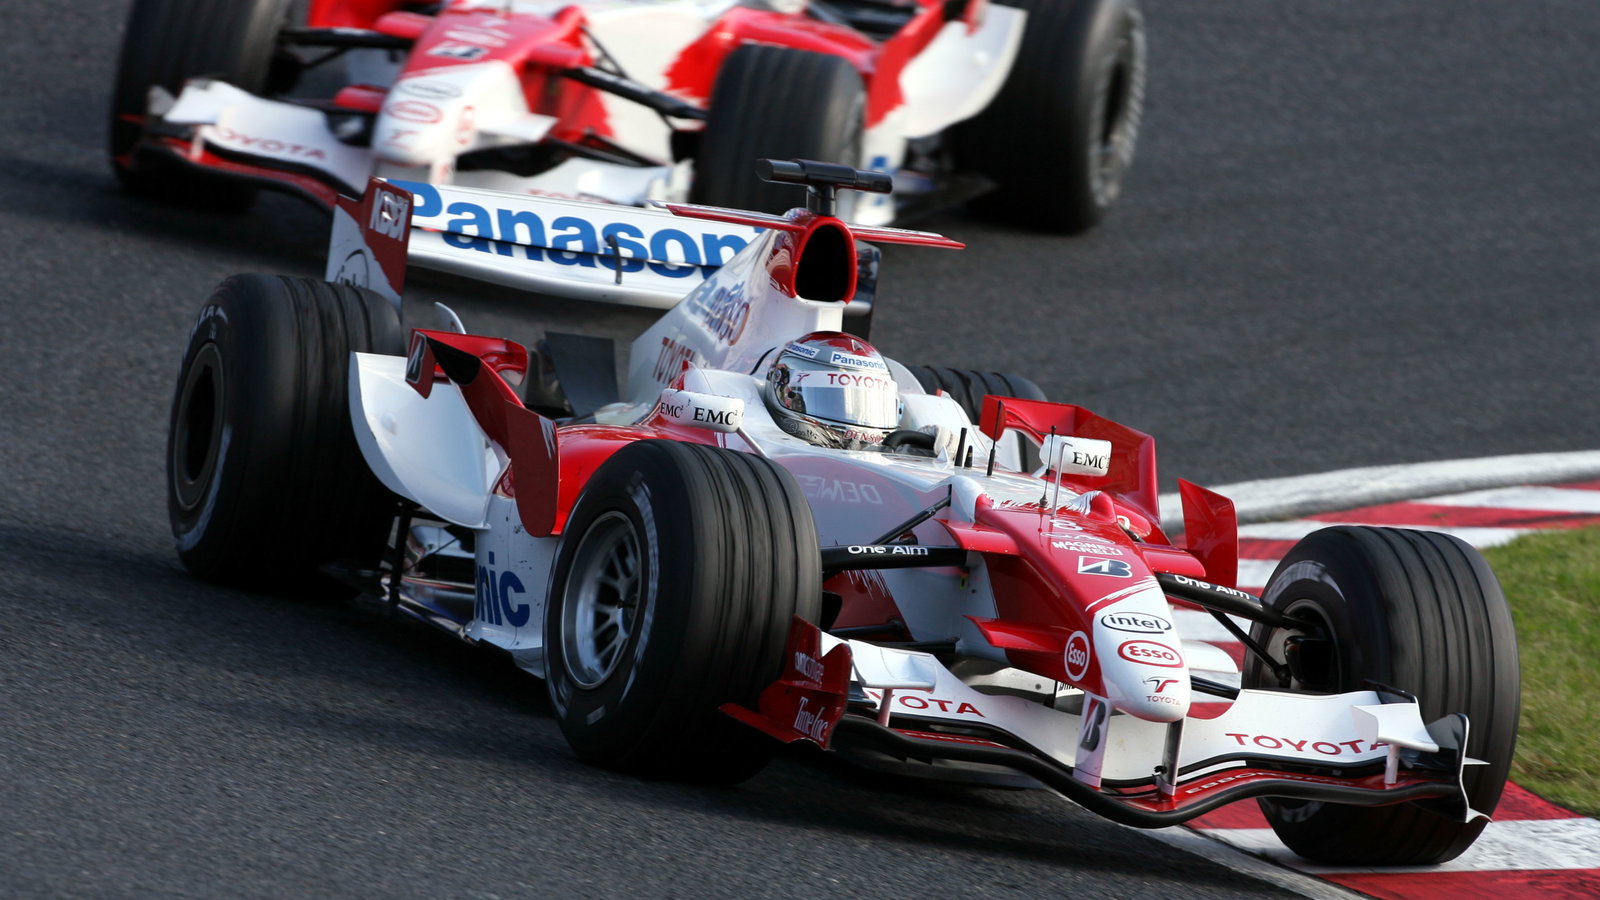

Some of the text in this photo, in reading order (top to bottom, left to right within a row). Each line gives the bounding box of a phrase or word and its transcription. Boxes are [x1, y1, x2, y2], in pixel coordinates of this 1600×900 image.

[387, 179, 767, 280] Panason
[832, 353, 886, 370] Panasonic
[827, 373, 890, 392] TOYOTA
[847, 545, 886, 554] One
[1174, 574, 1211, 589] One
[1107, 614, 1162, 630] intel
[1146, 695, 1181, 705] TOYOTA
